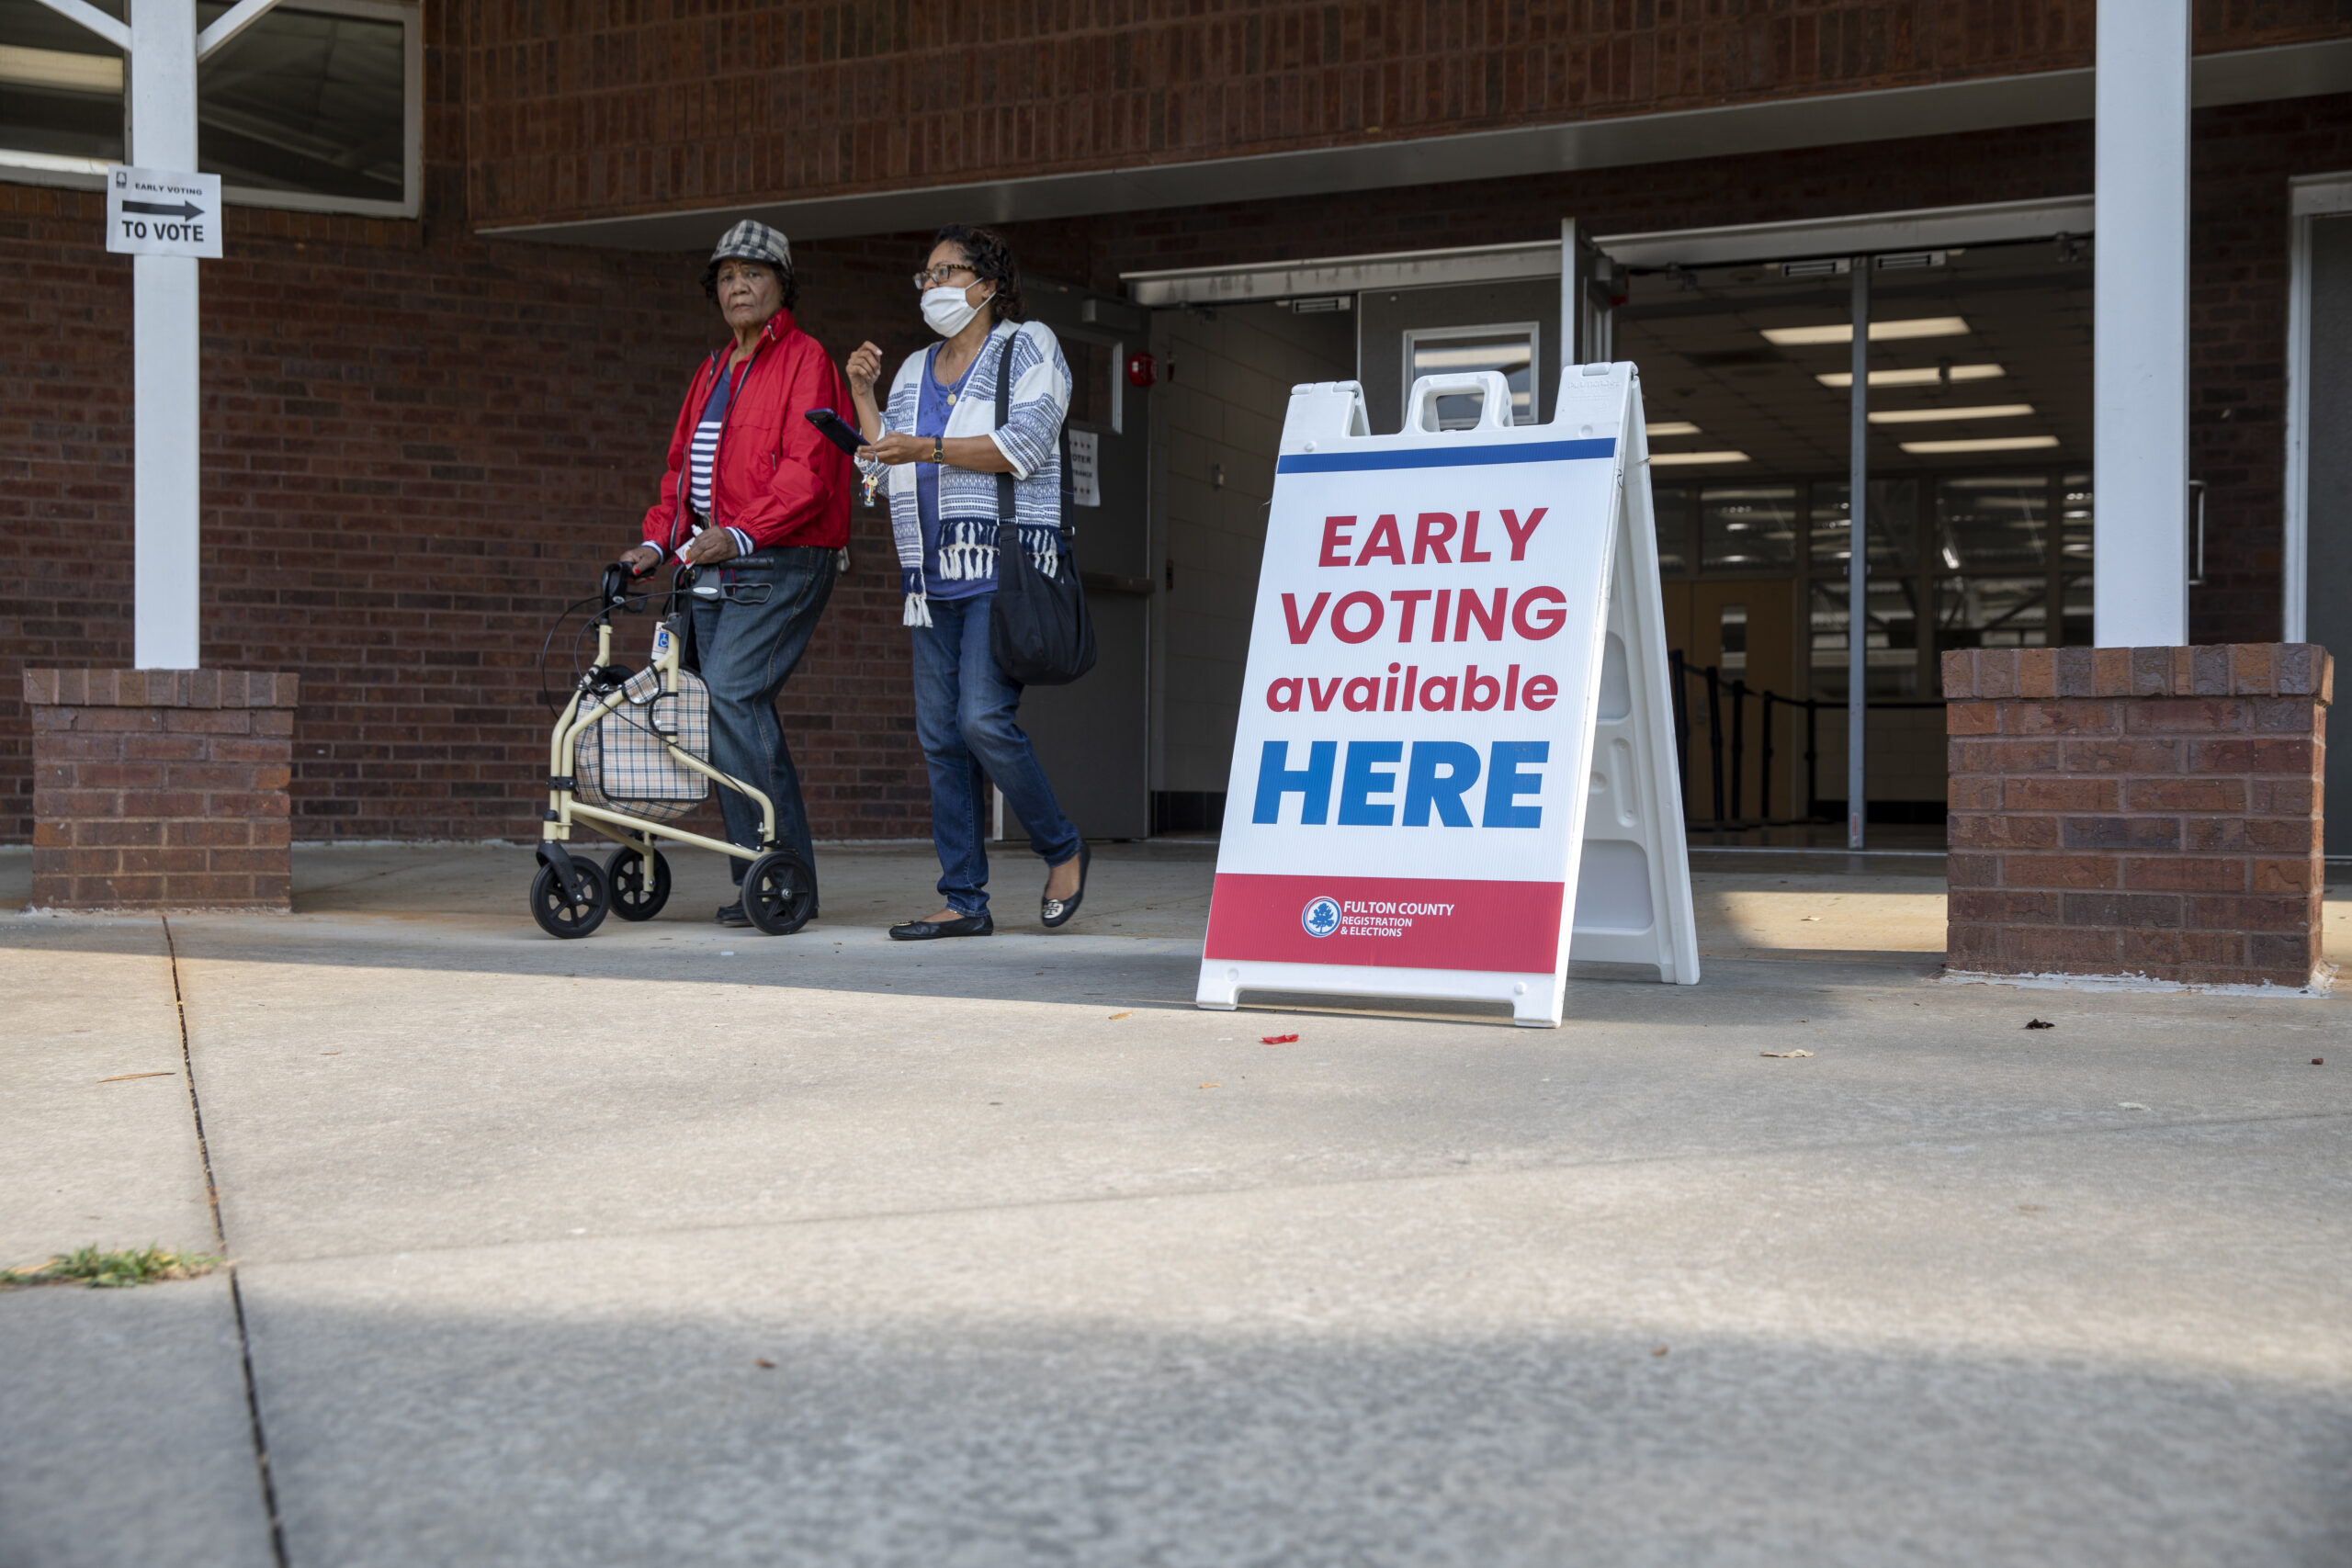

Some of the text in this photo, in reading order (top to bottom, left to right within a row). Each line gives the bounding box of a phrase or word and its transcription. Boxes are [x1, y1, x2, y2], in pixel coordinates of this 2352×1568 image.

[135, 183, 164, 192] EARLY
[167, 186, 202, 196] VOTING
[121, 220, 204, 243] TO VOTE
[1072, 454, 1091, 464] OTER
[1318, 508, 1549, 567] EARLY
[1281, 586, 1567, 644] VOTING
[1266, 662, 1558, 712] available
[1252, 740, 1550, 829] HERE
[1343, 901, 1454, 916] FULTON COUNTY
[1342, 917, 1412, 927] REGISTRATION
[1340, 927, 1402, 937] & ELECTIONS
